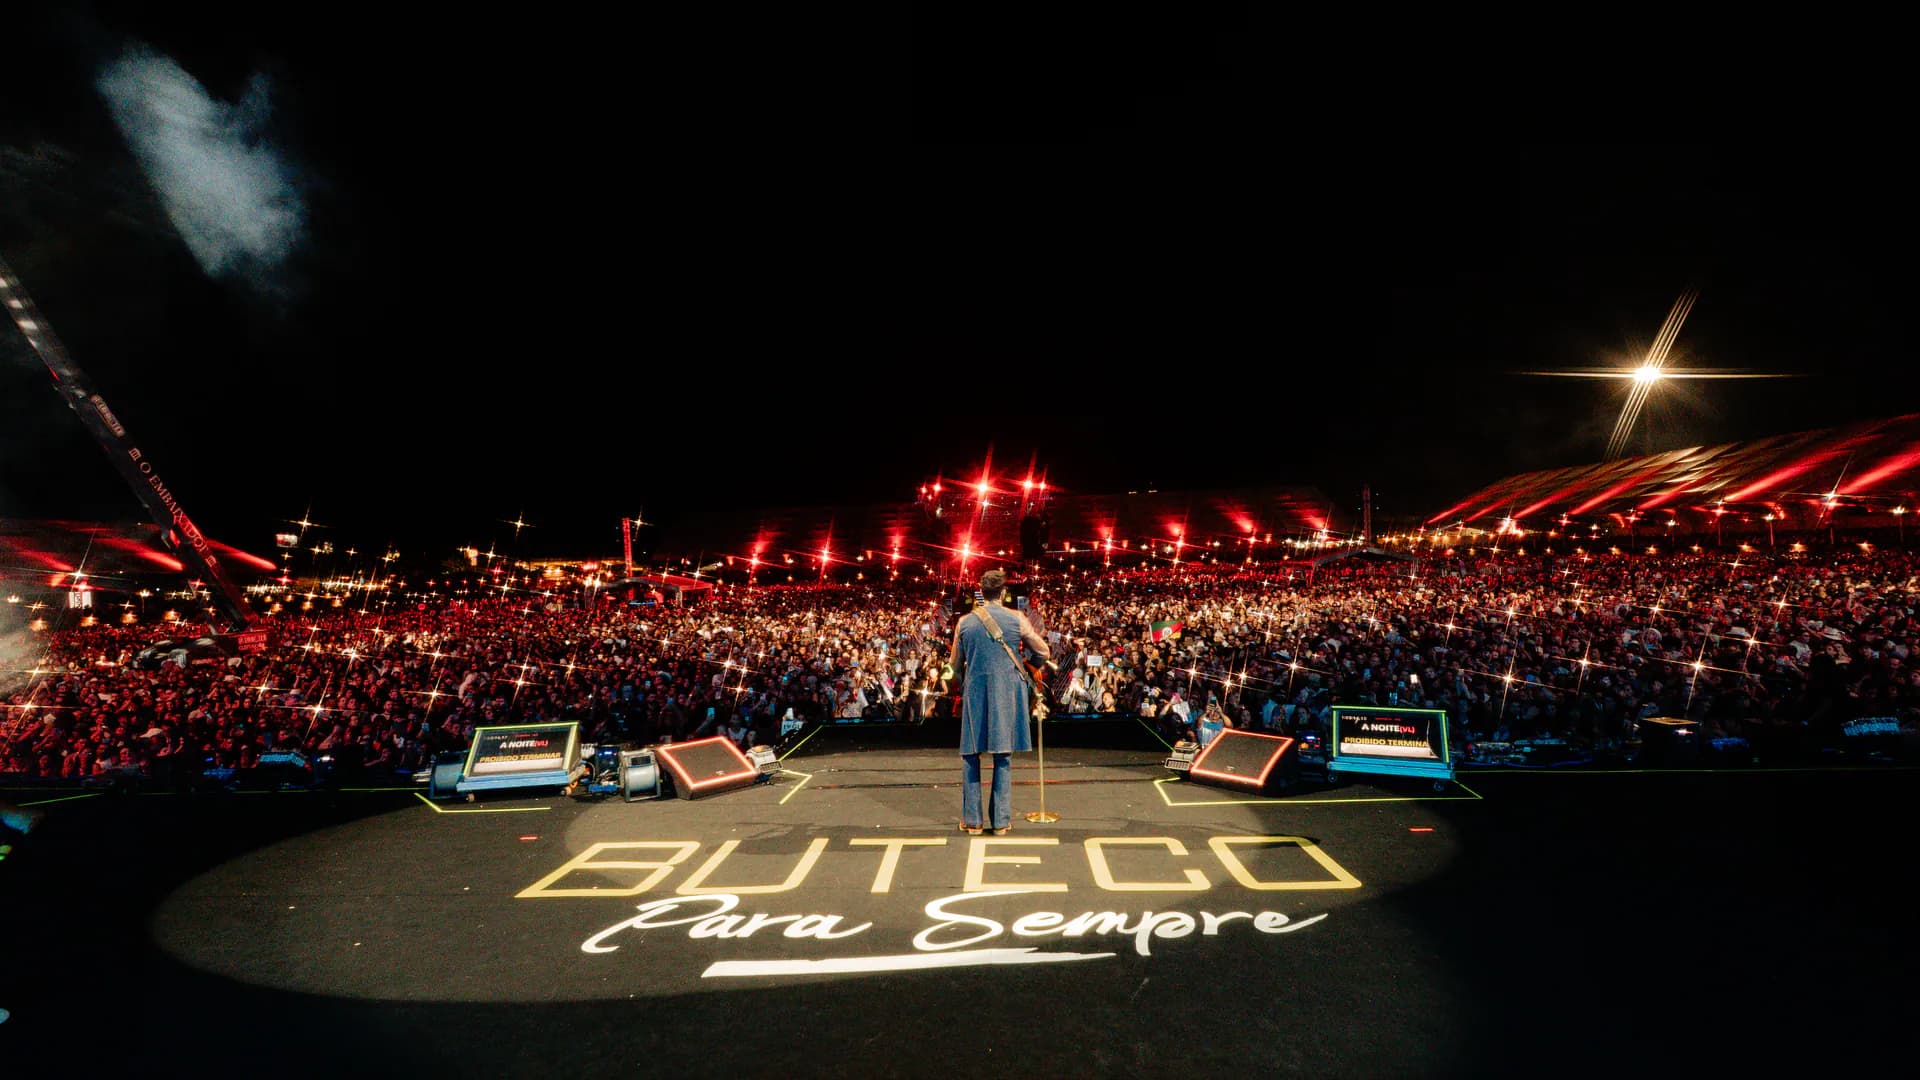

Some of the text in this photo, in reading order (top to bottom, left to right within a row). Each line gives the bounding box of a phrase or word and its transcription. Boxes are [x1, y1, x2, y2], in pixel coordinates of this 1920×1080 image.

[140, 462, 151, 474] O
[1361, 723, 1370, 731] A
[499, 741, 508, 749] A
[1344, 737, 1429, 748] PROIBIDO TERMINA
[480, 752, 562, 763] PROIBIDO TERMINAR
[514, 836, 1362, 898] BUTECO
[581, 890, 1328, 956] Para Sempre
